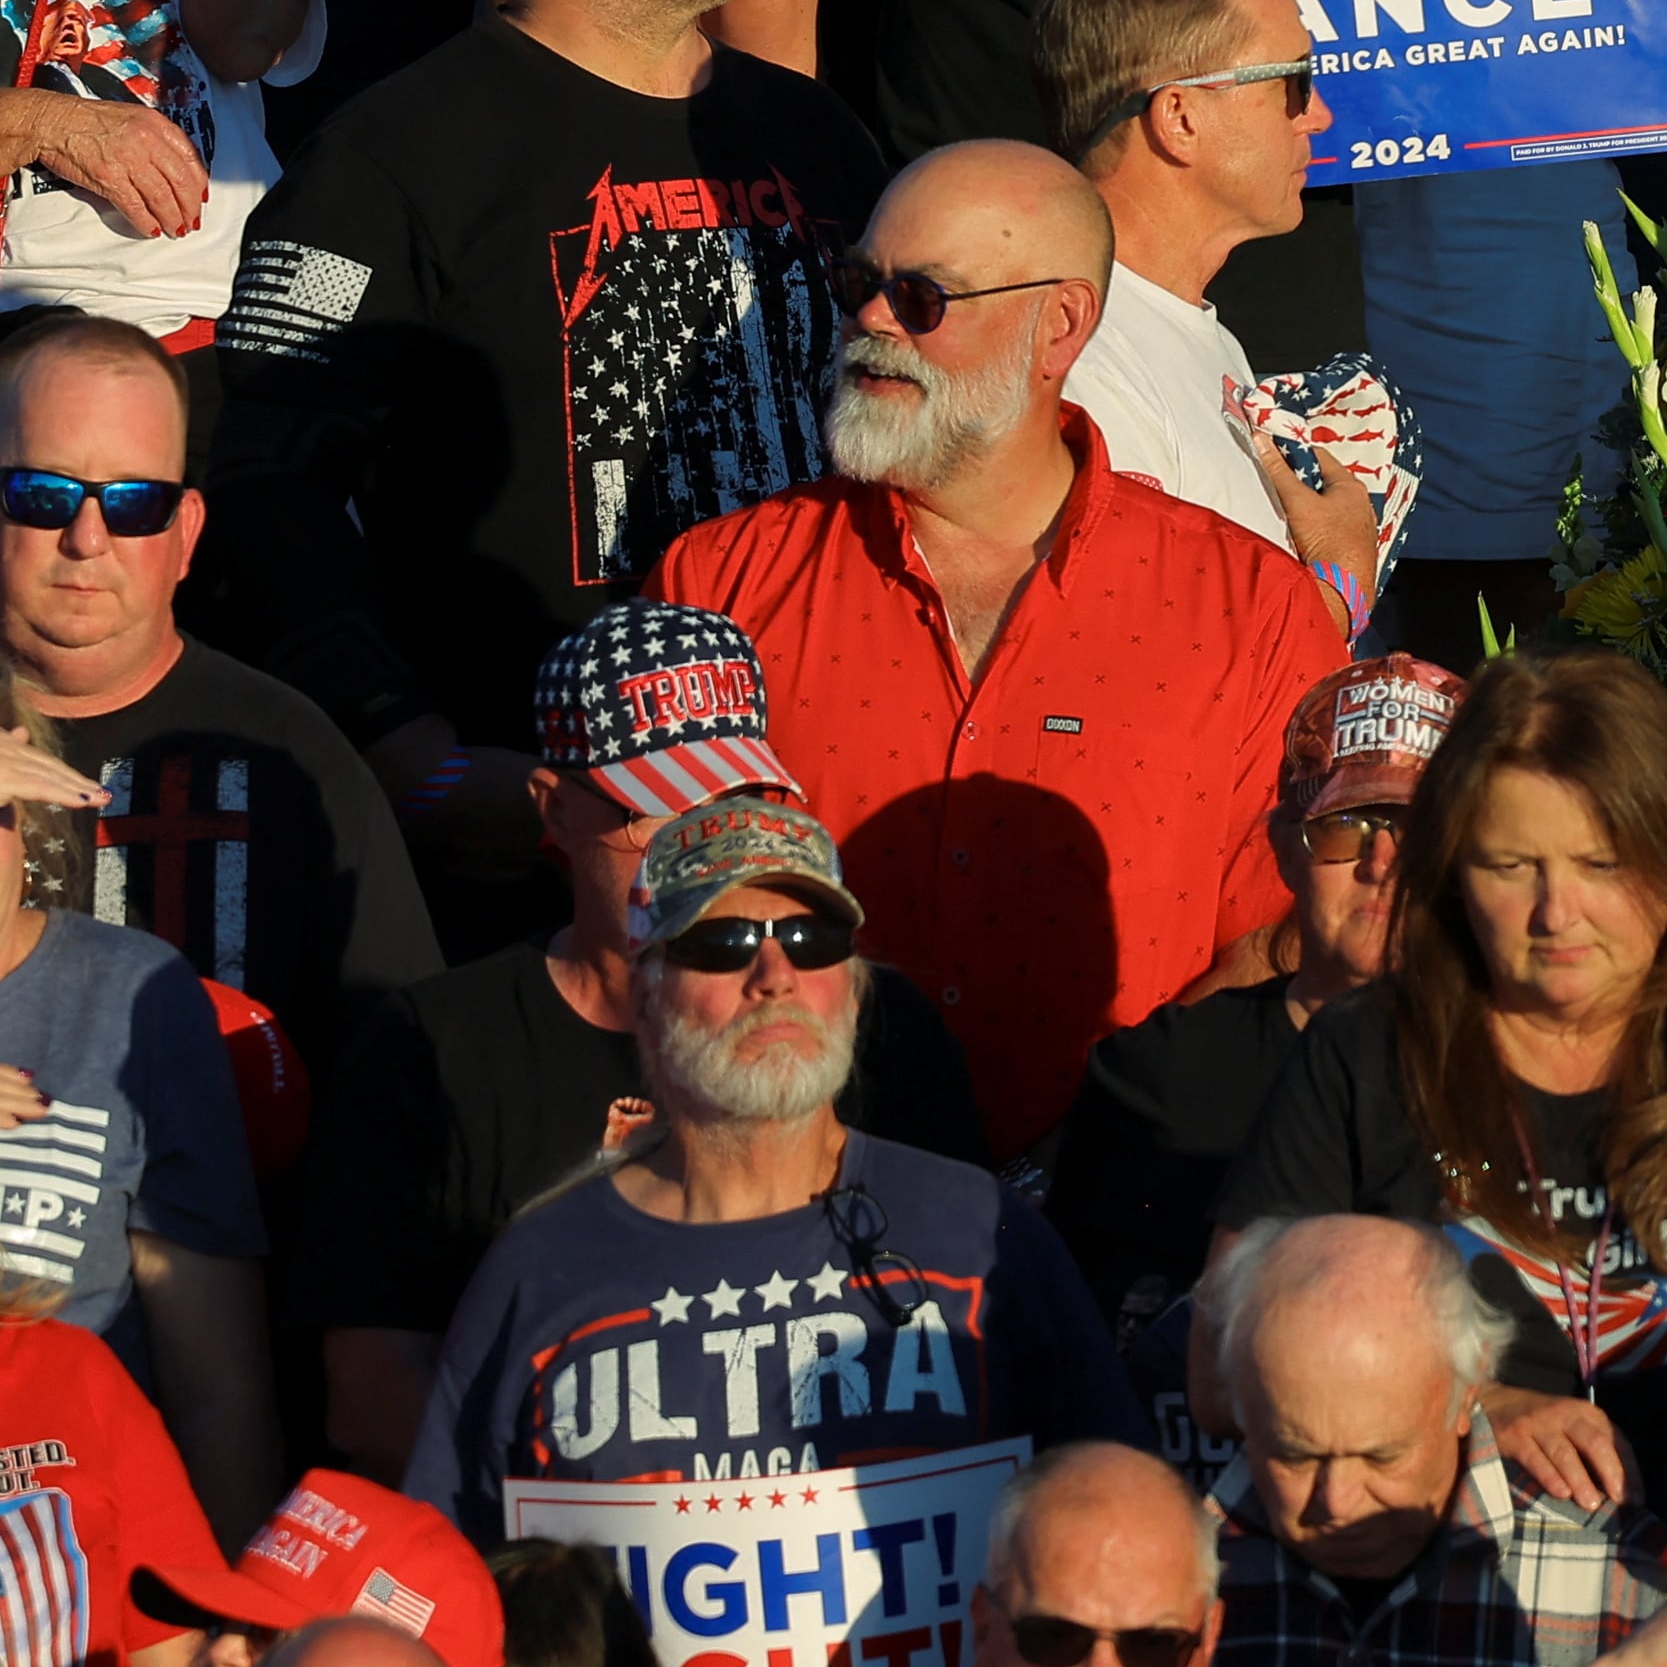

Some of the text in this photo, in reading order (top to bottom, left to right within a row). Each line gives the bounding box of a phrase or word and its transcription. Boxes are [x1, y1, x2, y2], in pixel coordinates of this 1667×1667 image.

[1404, 36, 1506, 67] GREAT
[1517, 24, 1627, 54] AGAIN!
[1351, 134, 1451, 170] 2024
[618, 659, 757, 733] TRUMP
[1348, 681, 1446, 711] WOMEN
[1366, 701, 1422, 719] FOR
[673, 810, 813, 850] TRUMP
[552, 1301, 968, 1461] ULTRA
[693, 1440, 820, 1481] MAGA
